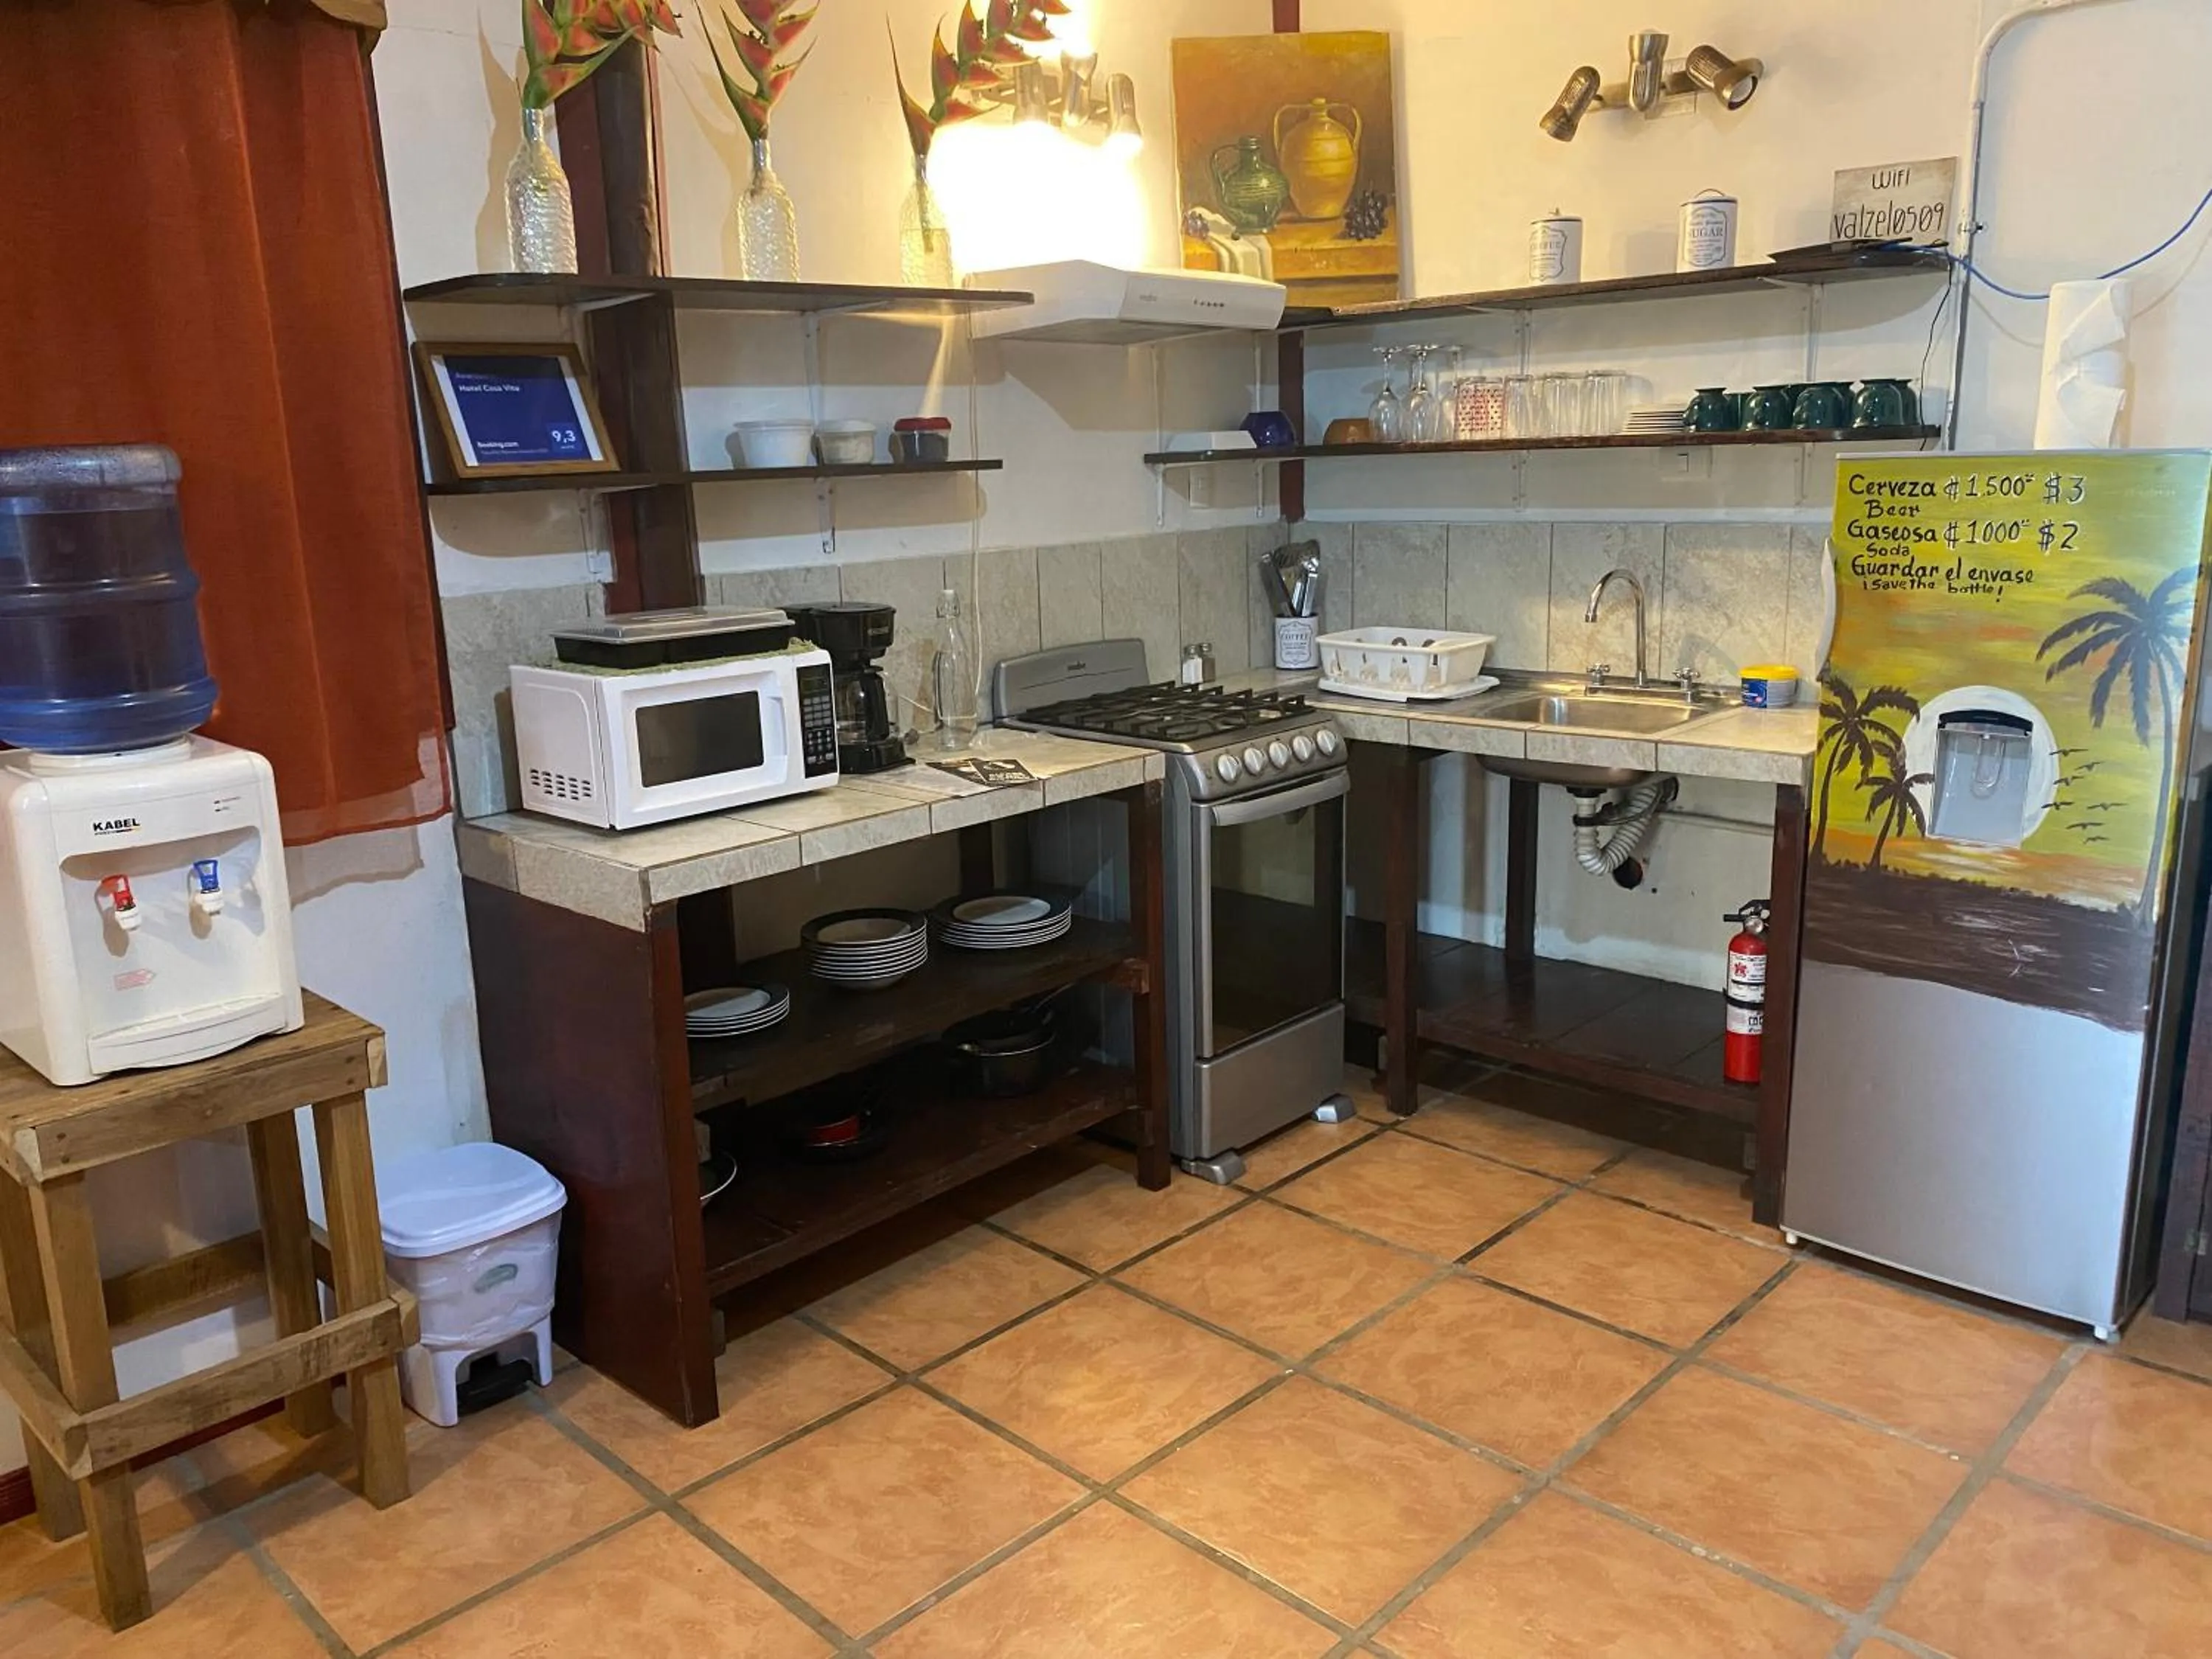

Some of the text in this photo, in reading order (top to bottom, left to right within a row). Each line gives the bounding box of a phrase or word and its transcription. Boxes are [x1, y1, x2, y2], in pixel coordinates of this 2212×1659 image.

[1688, 227, 1723, 238] UGAR
[1848, 473, 1936, 498] Cerveza
[1847, 519, 1938, 543] Gaseosa
[1865, 543, 1910, 558] Soda
[1851, 554, 2034, 584] Guardar el envase
[93, 818, 140, 832] KABEL
